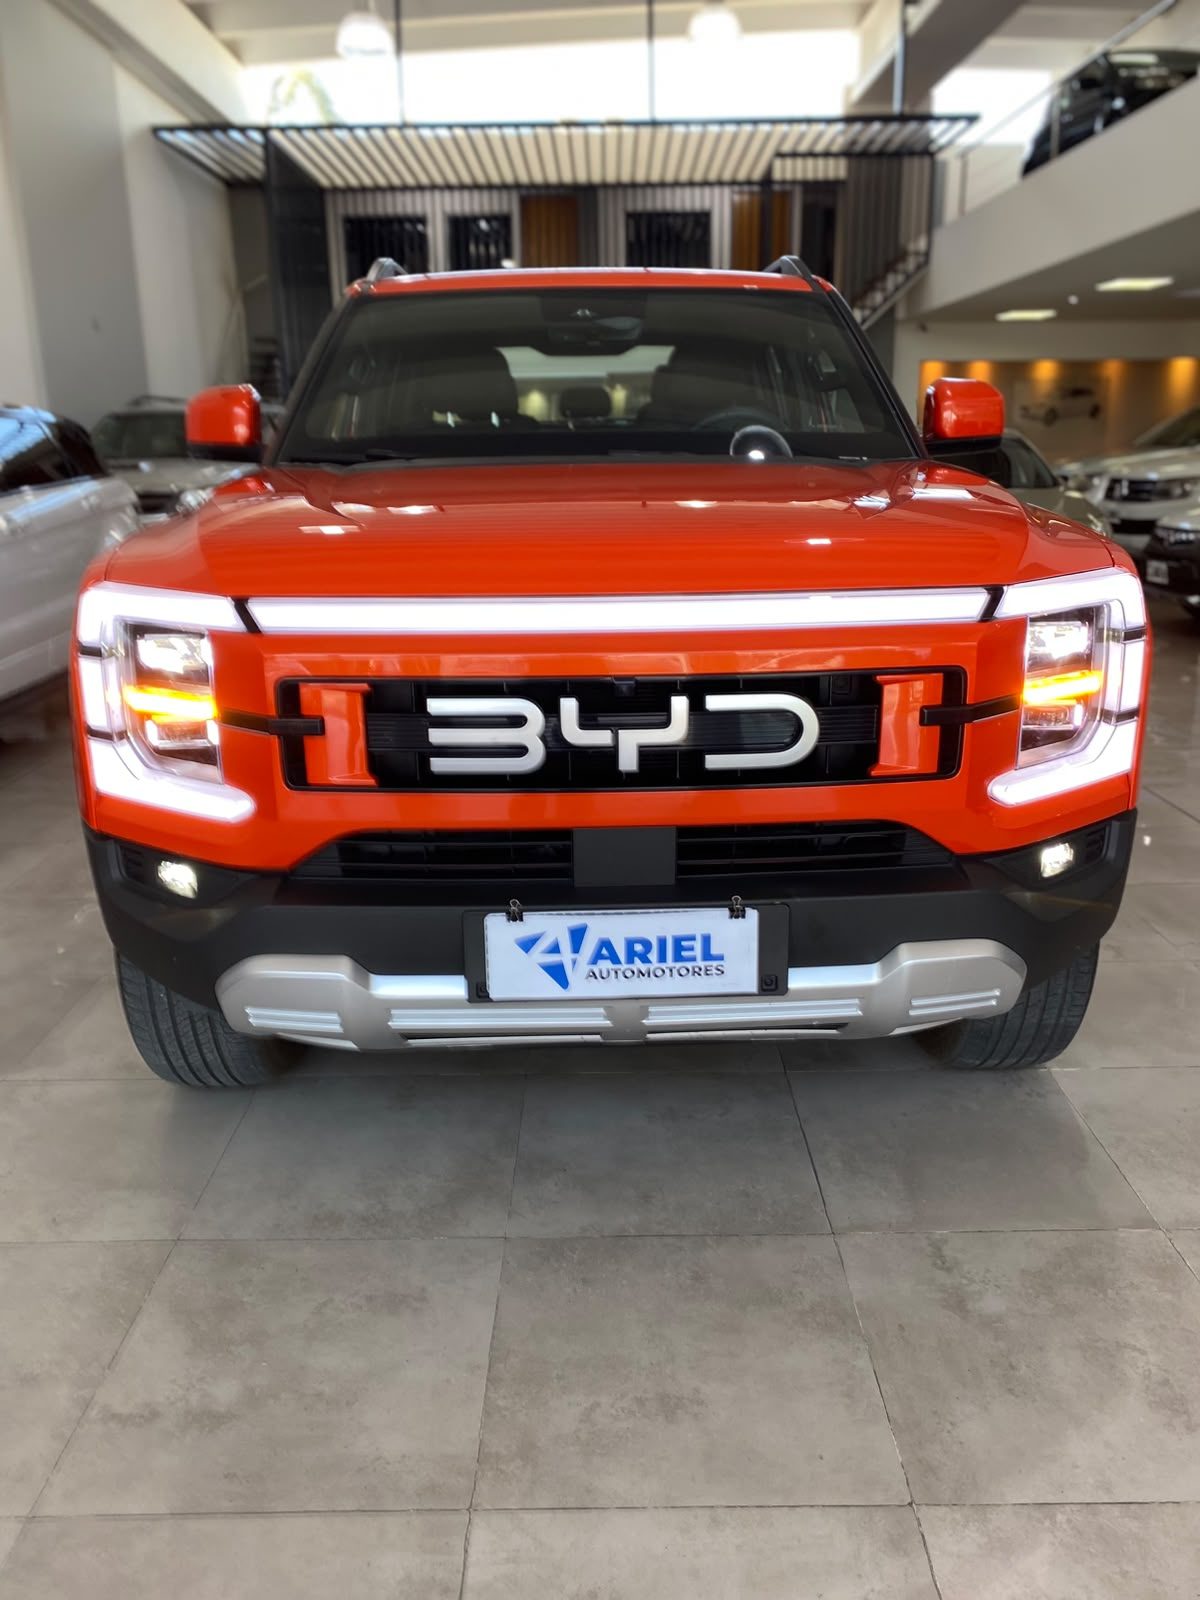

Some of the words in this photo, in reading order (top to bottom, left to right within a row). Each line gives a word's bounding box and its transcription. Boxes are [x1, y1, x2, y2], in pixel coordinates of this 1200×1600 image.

[426, 693, 820, 774] BYD
[587, 933, 725, 965] ARIEL
[585, 965, 725, 981] AUTOMOTORES
